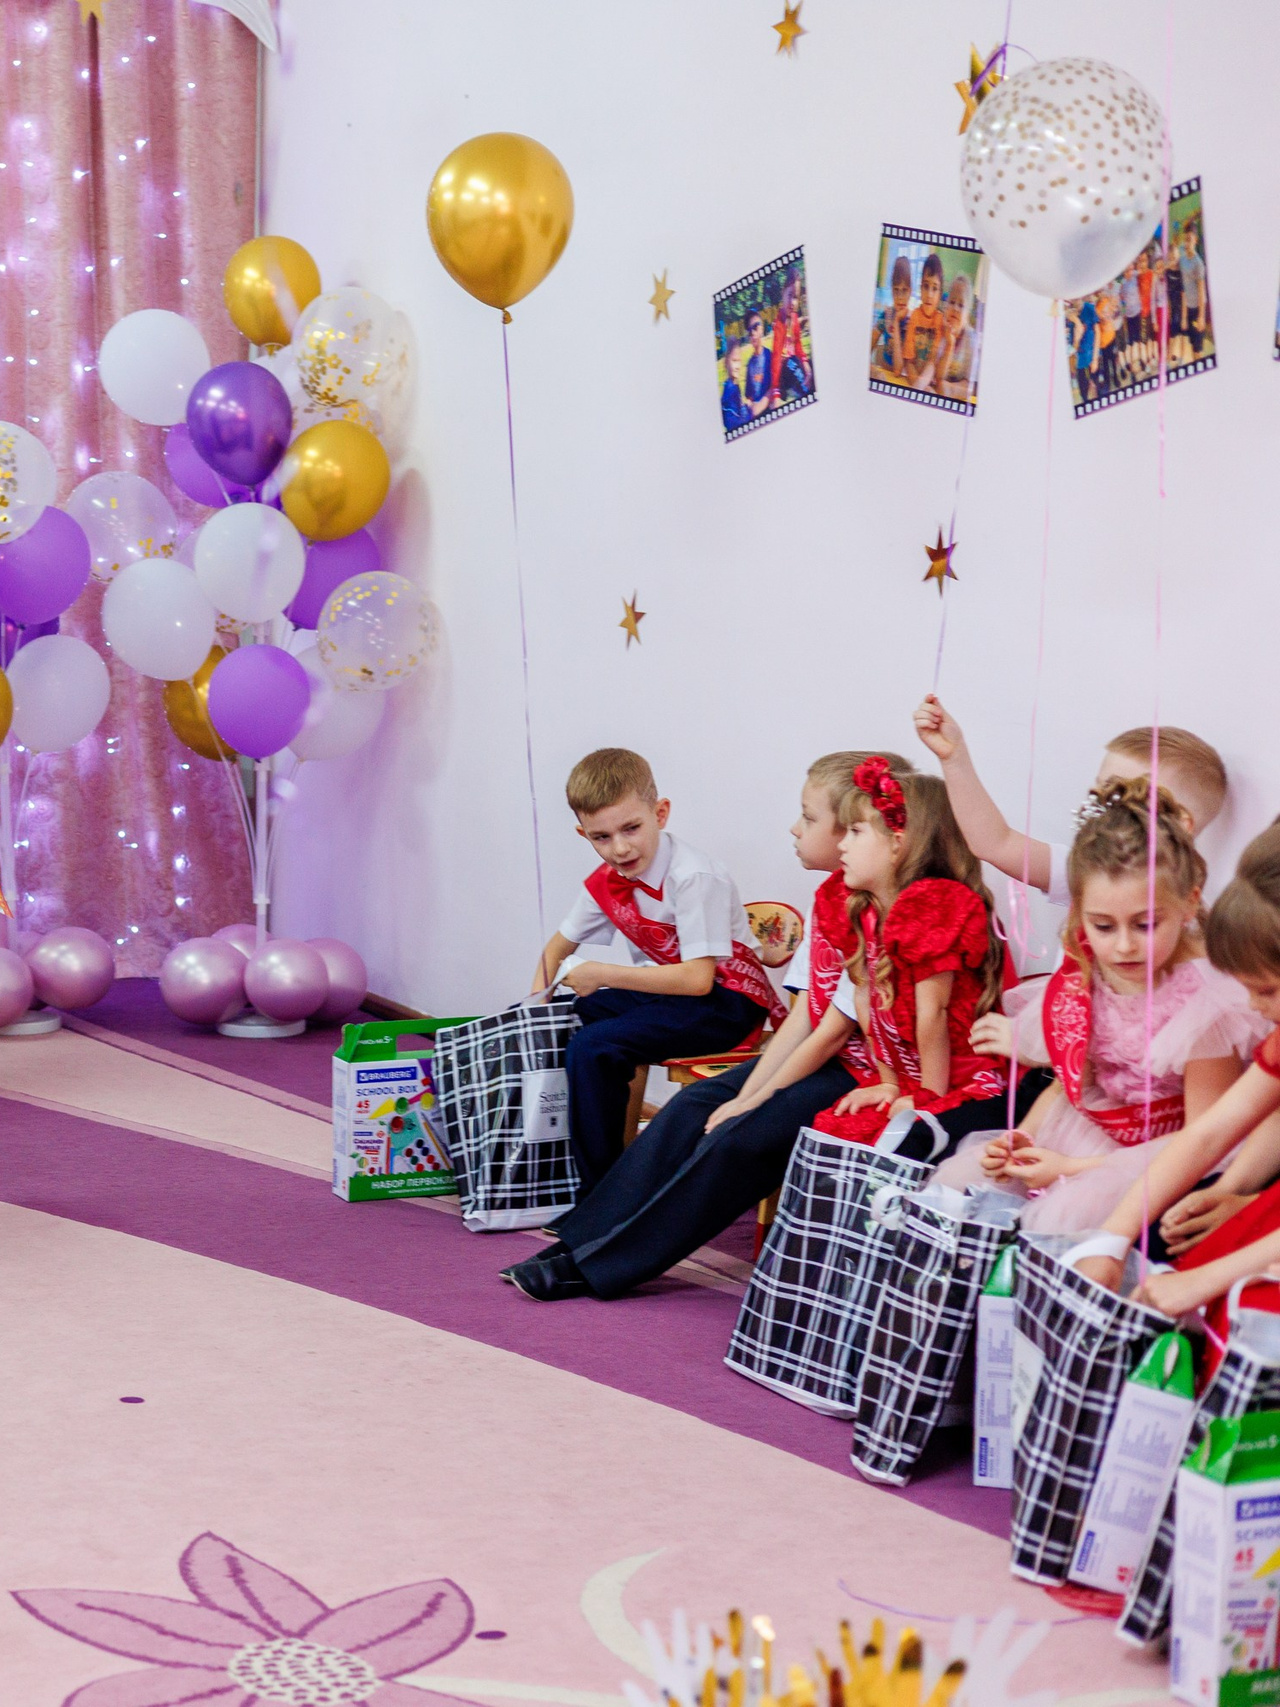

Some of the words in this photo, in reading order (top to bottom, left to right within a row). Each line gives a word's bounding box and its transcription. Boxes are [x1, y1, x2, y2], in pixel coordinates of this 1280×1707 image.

[356, 1087, 396, 1097] SCHOOL
[398, 1085, 418, 1094] BOX
[356, 1099, 370, 1109] 45
[371, 1179, 405, 1189] НАБОР
